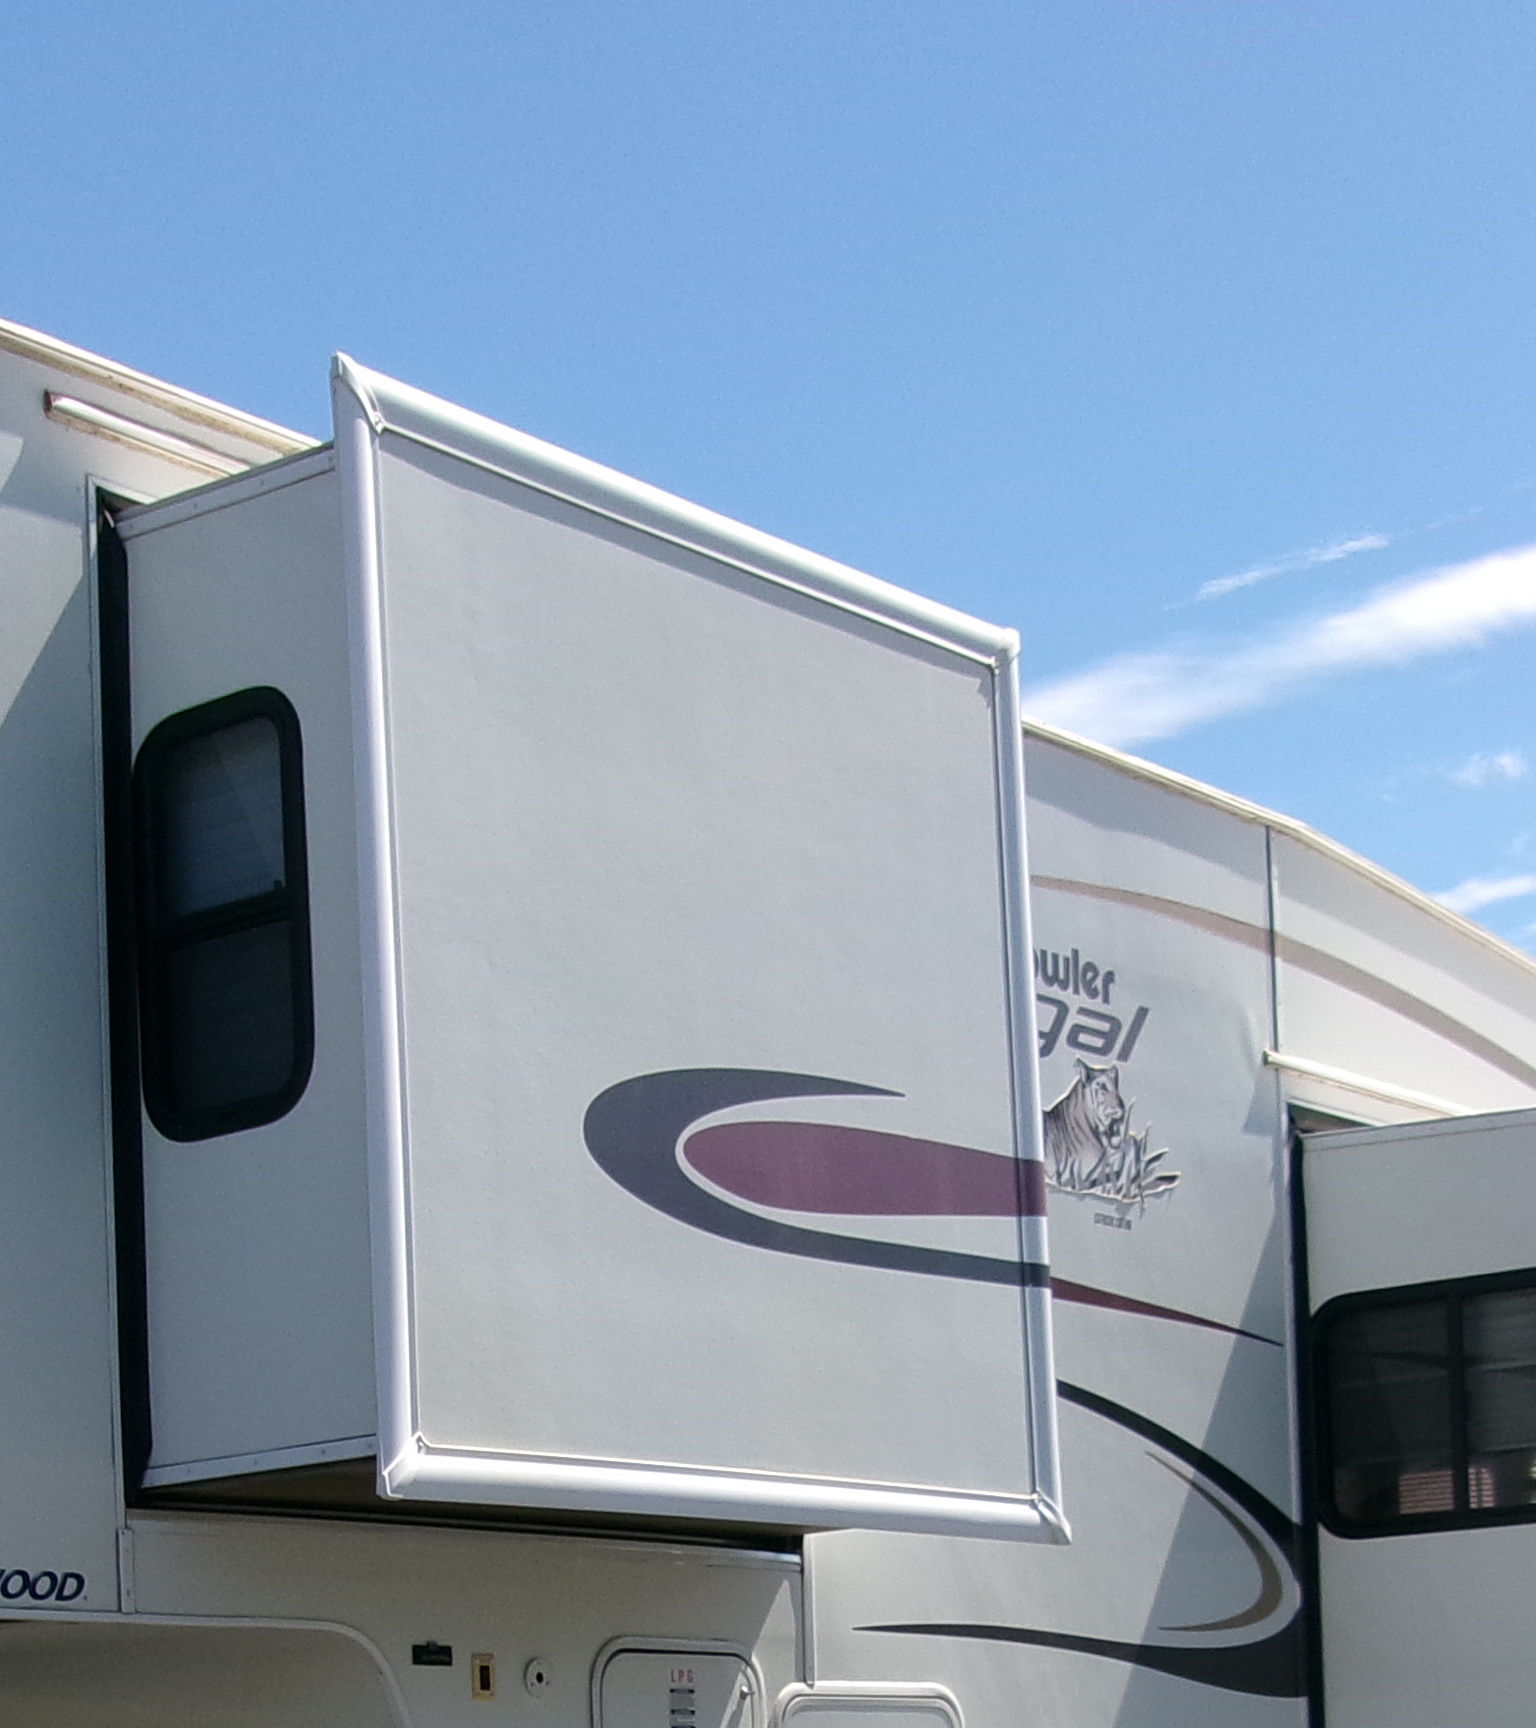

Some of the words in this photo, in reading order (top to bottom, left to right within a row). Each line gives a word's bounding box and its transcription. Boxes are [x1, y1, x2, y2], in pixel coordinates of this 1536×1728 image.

[1033, 947, 1115, 1006] wler
[1036, 993, 1150, 1063] gal
[669, 1669, 694, 1684] LPG
